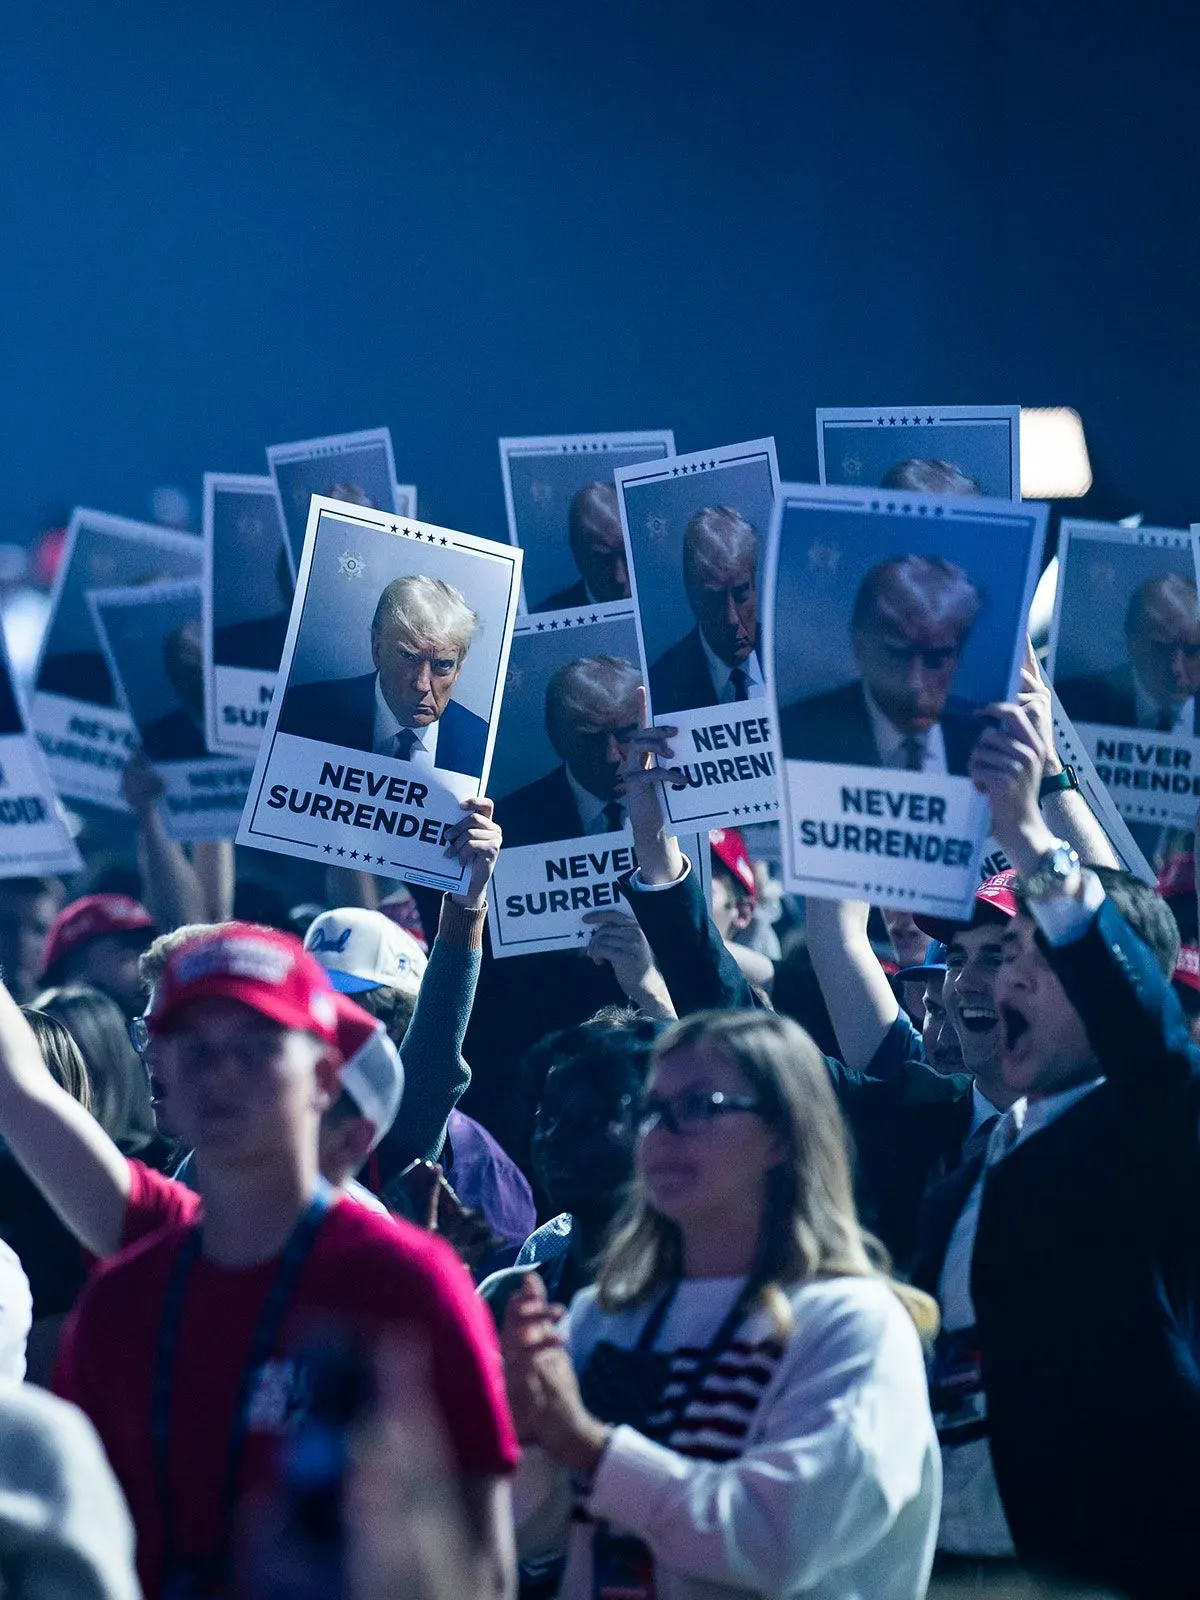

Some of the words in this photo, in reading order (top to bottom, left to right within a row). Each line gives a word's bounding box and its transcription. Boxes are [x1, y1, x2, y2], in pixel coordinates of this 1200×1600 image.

[1097, 740, 1192, 770] NEVER
[319, 762, 428, 808] NEVER
[842, 786, 946, 825] NEVER
[800, 819, 973, 867] SURRENDER
[545, 846, 639, 882] NEVE
